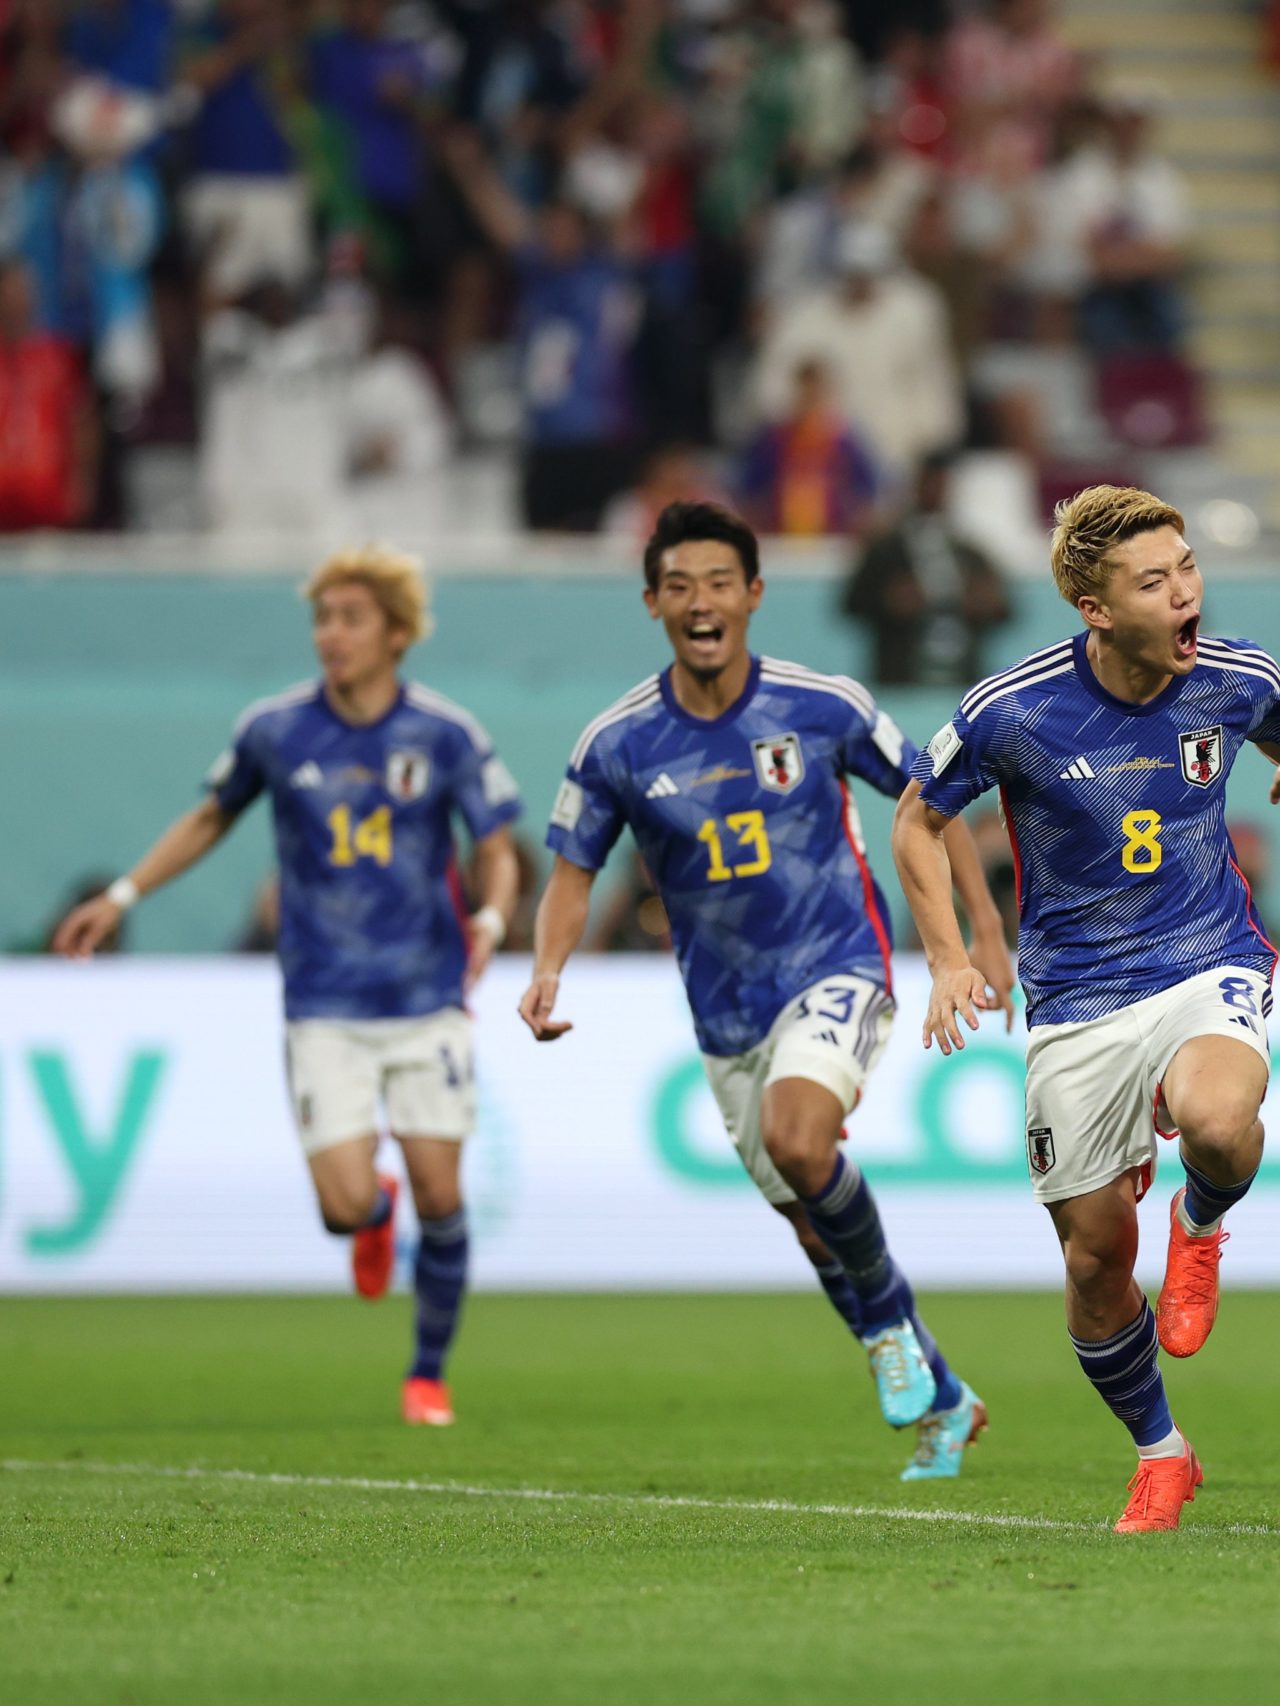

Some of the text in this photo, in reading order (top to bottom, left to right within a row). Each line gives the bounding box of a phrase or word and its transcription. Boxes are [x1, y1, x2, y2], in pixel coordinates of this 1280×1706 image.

[1190, 730, 1213, 740] JAPAN
[328, 803, 393, 868] 14
[697, 809, 772, 881] 13
[1122, 809, 1163, 874] 8
[1218, 977, 1258, 1016] 8
[0, 1045, 167, 1258] y
